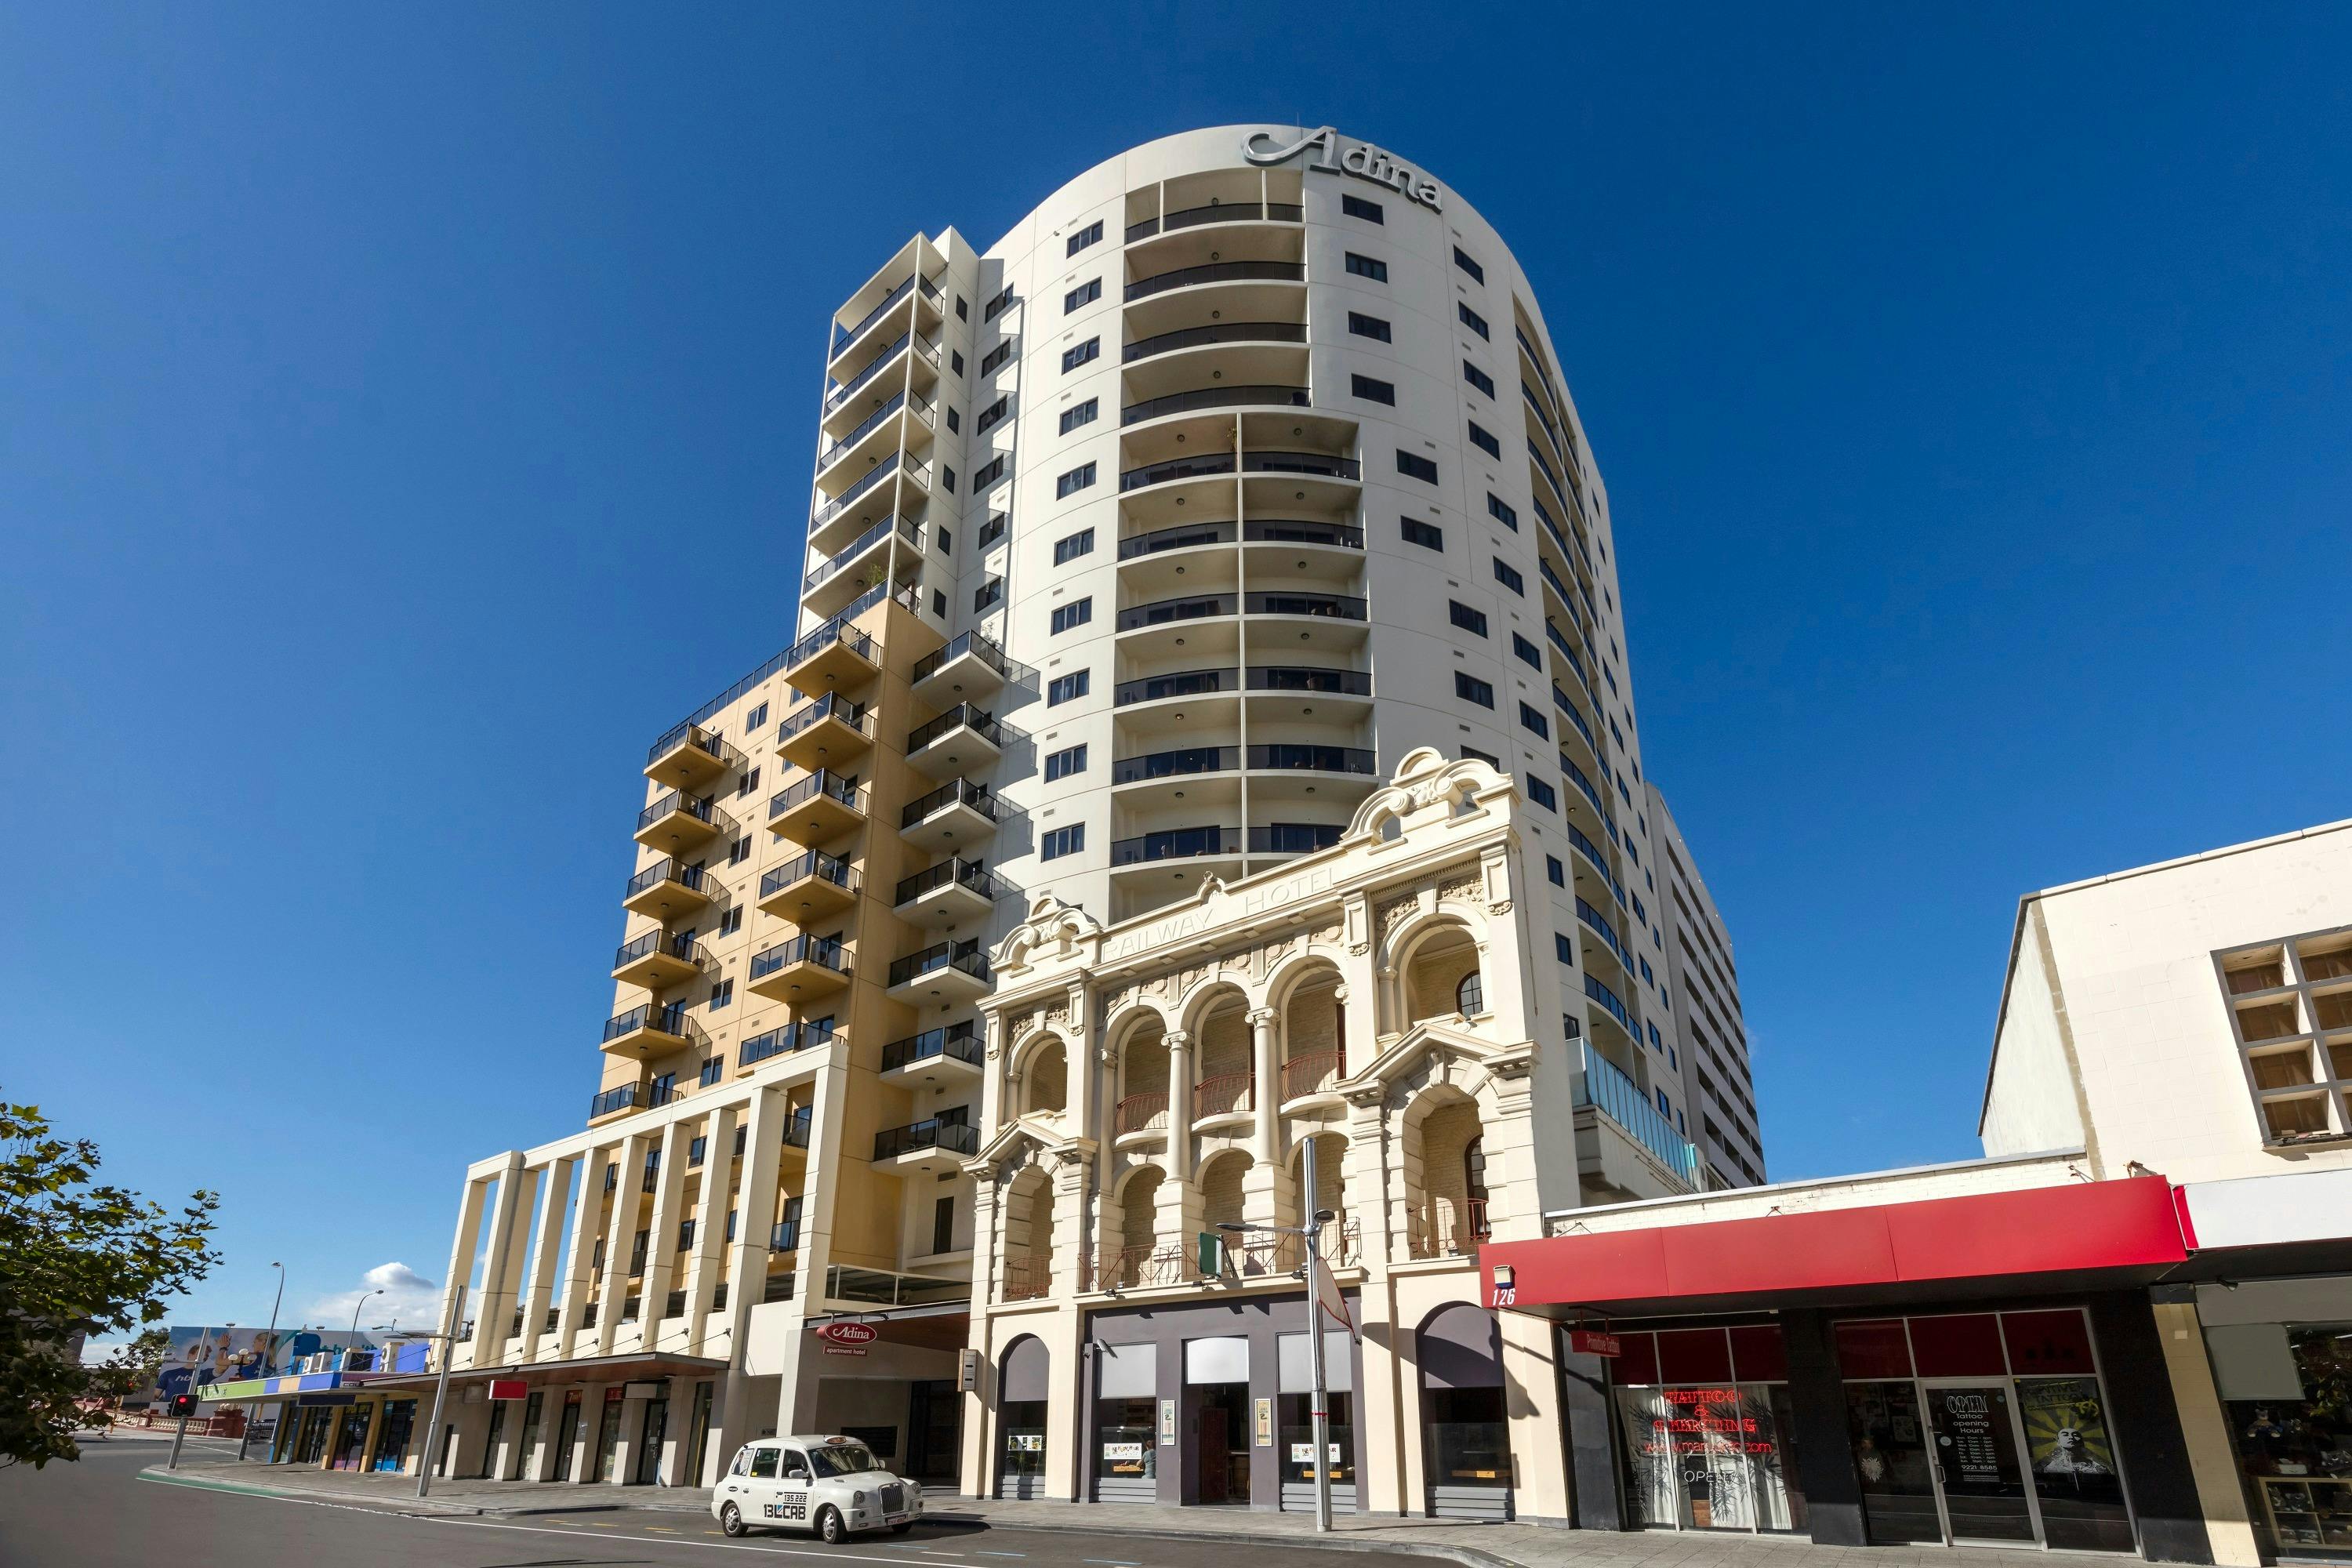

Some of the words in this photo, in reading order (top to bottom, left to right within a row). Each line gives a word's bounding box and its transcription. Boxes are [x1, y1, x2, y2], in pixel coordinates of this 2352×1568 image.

[1240, 125, 1443, 215] Adina
[1103, 909, 1214, 962] RAILWAY
[1246, 867, 1334, 916] HOTEL
[1492, 1288, 1516, 1306] 126
[833, 1326, 869, 1339] Adina
[1587, 1333, 1606, 1352] Primitive
[1606, 1336, 1621, 1353] Tattoo
[1664, 1390, 1742, 1403] TATTOO
[1947, 1396, 1988, 1413] OPEN
[1694, 1405, 1710, 1417] &
[1653, 1418, 1756, 1433] PIERCING
[1684, 1470, 1726, 1483] OPEN
